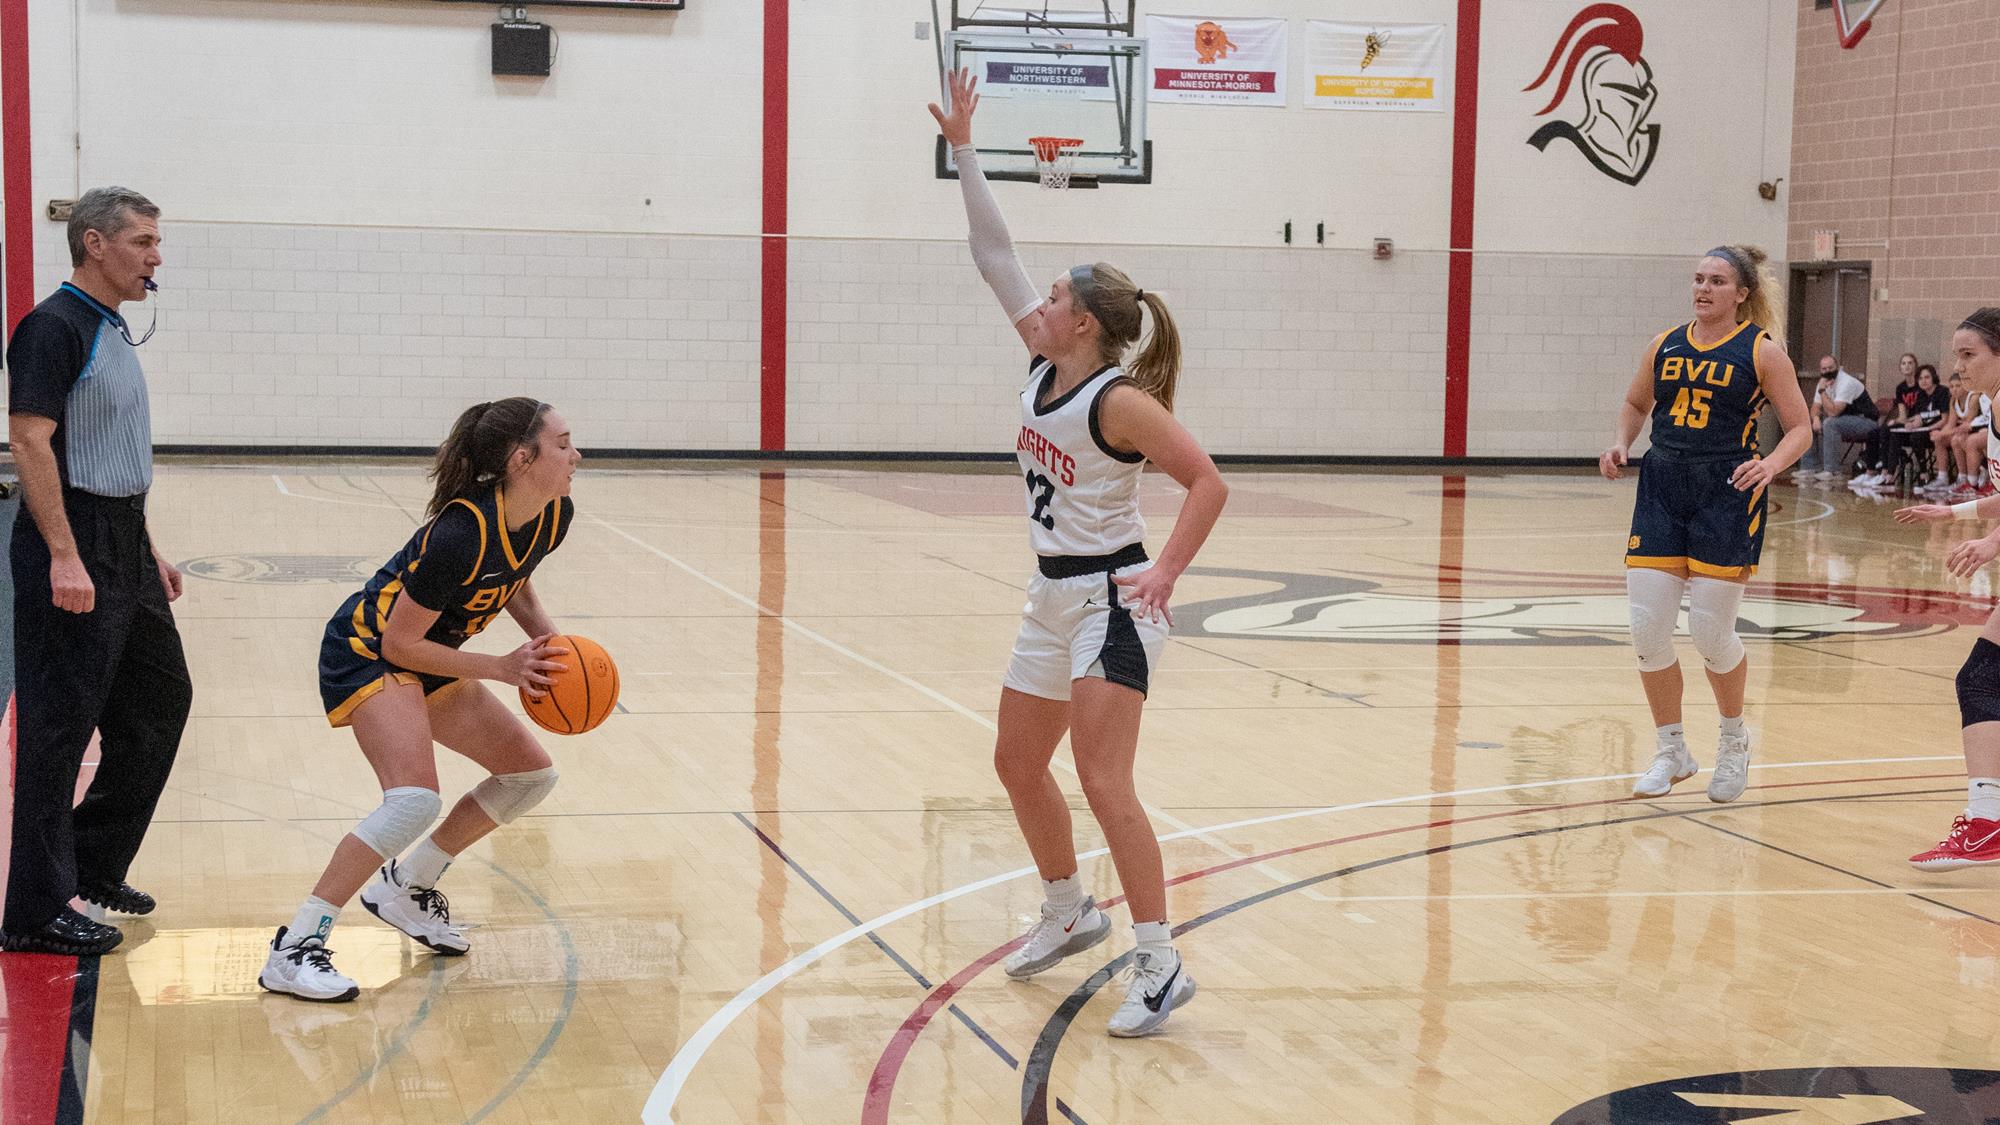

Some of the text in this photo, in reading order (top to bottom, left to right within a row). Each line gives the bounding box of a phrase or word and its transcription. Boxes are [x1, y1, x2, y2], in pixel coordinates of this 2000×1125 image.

[1012, 65, 1084, 75] UNIVERSITY OF
[1009, 74, 1087, 84] NORTHWESTERN
[1180, 71, 1250, 82] UNIVERSITY OF
[1168, 80, 1262, 91] MINNESOTA-MORRIS
[1661, 357, 1735, 387] BVU
[1669, 387, 1713, 429] 45
